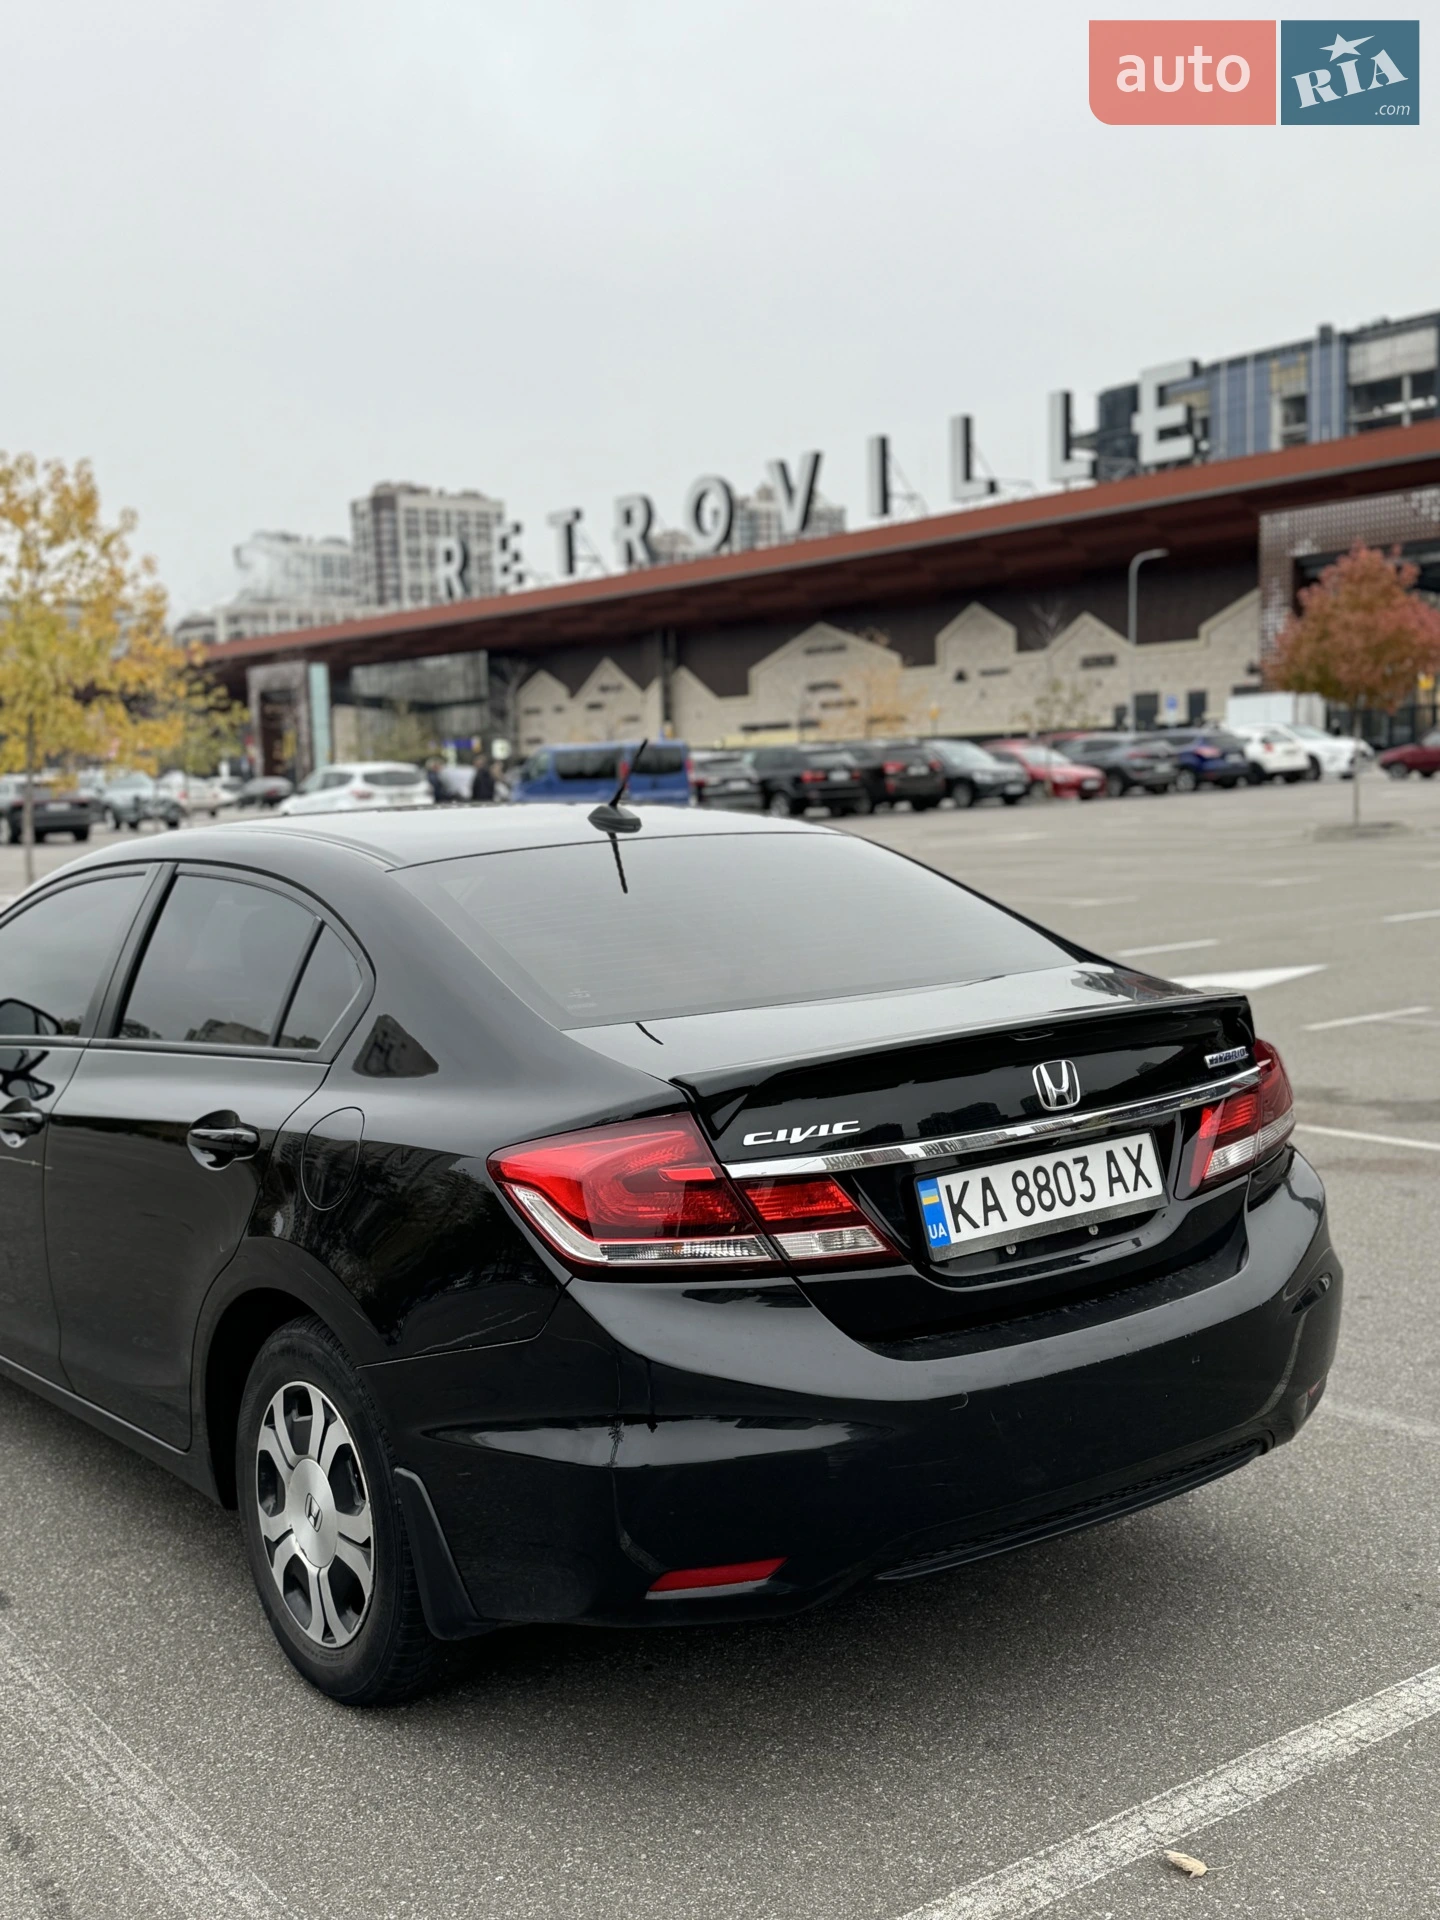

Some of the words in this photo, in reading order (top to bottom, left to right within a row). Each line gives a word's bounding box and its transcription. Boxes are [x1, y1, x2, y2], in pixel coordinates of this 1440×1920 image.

[436, 359, 1200, 601] RETROVILLE
[743, 1120, 861, 1146] CIVIC
[945, 1176, 1007, 1233] KA
[1011, 1155, 1096, 1217] 8803
[1105, 1143, 1153, 1197] AX
[928, 1221, 948, 1240] UA
